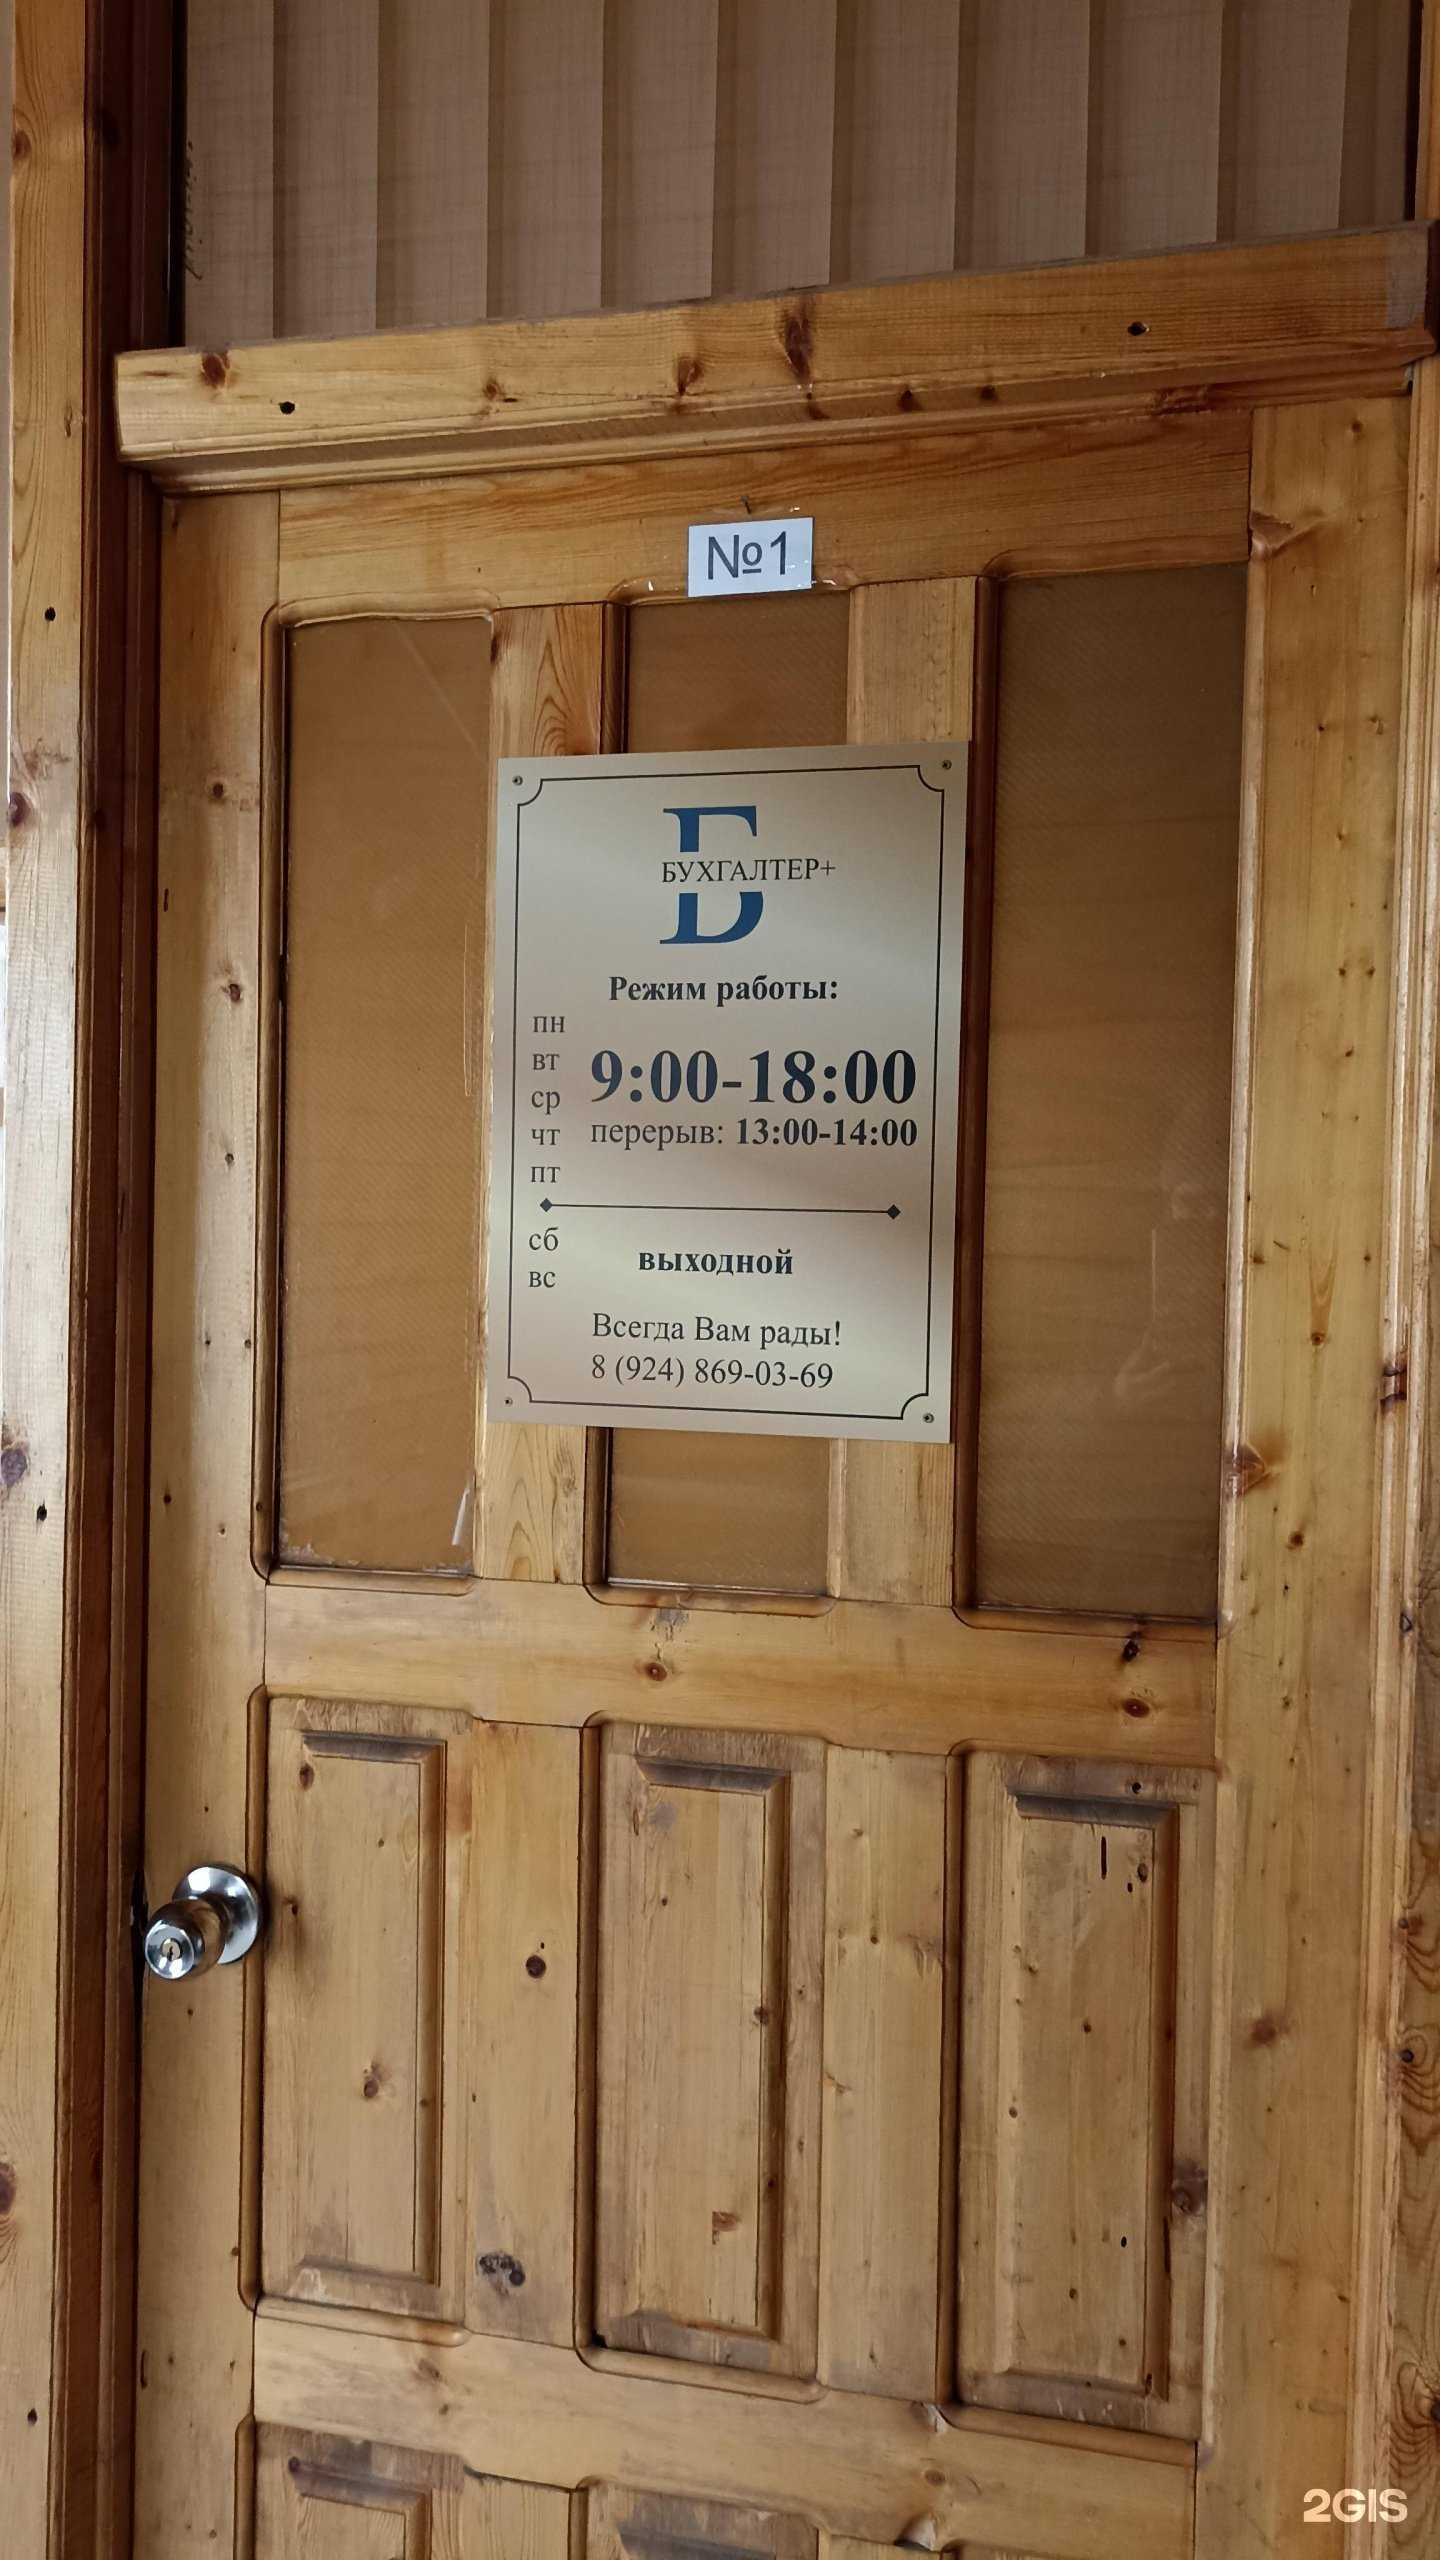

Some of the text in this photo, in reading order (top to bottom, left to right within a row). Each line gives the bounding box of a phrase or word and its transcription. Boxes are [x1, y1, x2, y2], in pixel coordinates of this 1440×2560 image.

[707, 530, 787, 581] №1
[662, 858, 836, 884] БУХГАЛТЕР+
[609, 975, 839, 1006] Режим работы:
[532, 1016, 565, 1033] пн
[532, 1053, 560, 1071] вт
[591, 1049, 916, 1104] 9:00-18:00
[532, 1091, 560, 1113] ср
[532, 1127, 560, 1146] чт
[591, 1118, 917, 1150] перерыв: 13:00-14:00
[531, 1165, 560, 1183] пт
[528, 1227, 559, 1252] сб
[639, 1249, 793, 1275] выходной
[528, 1270, 555, 1288] вс
[592, 1313, 841, 1348] Всегда Вам рады!
[592, 1355, 833, 1388] 8 (924) 869-03-69
